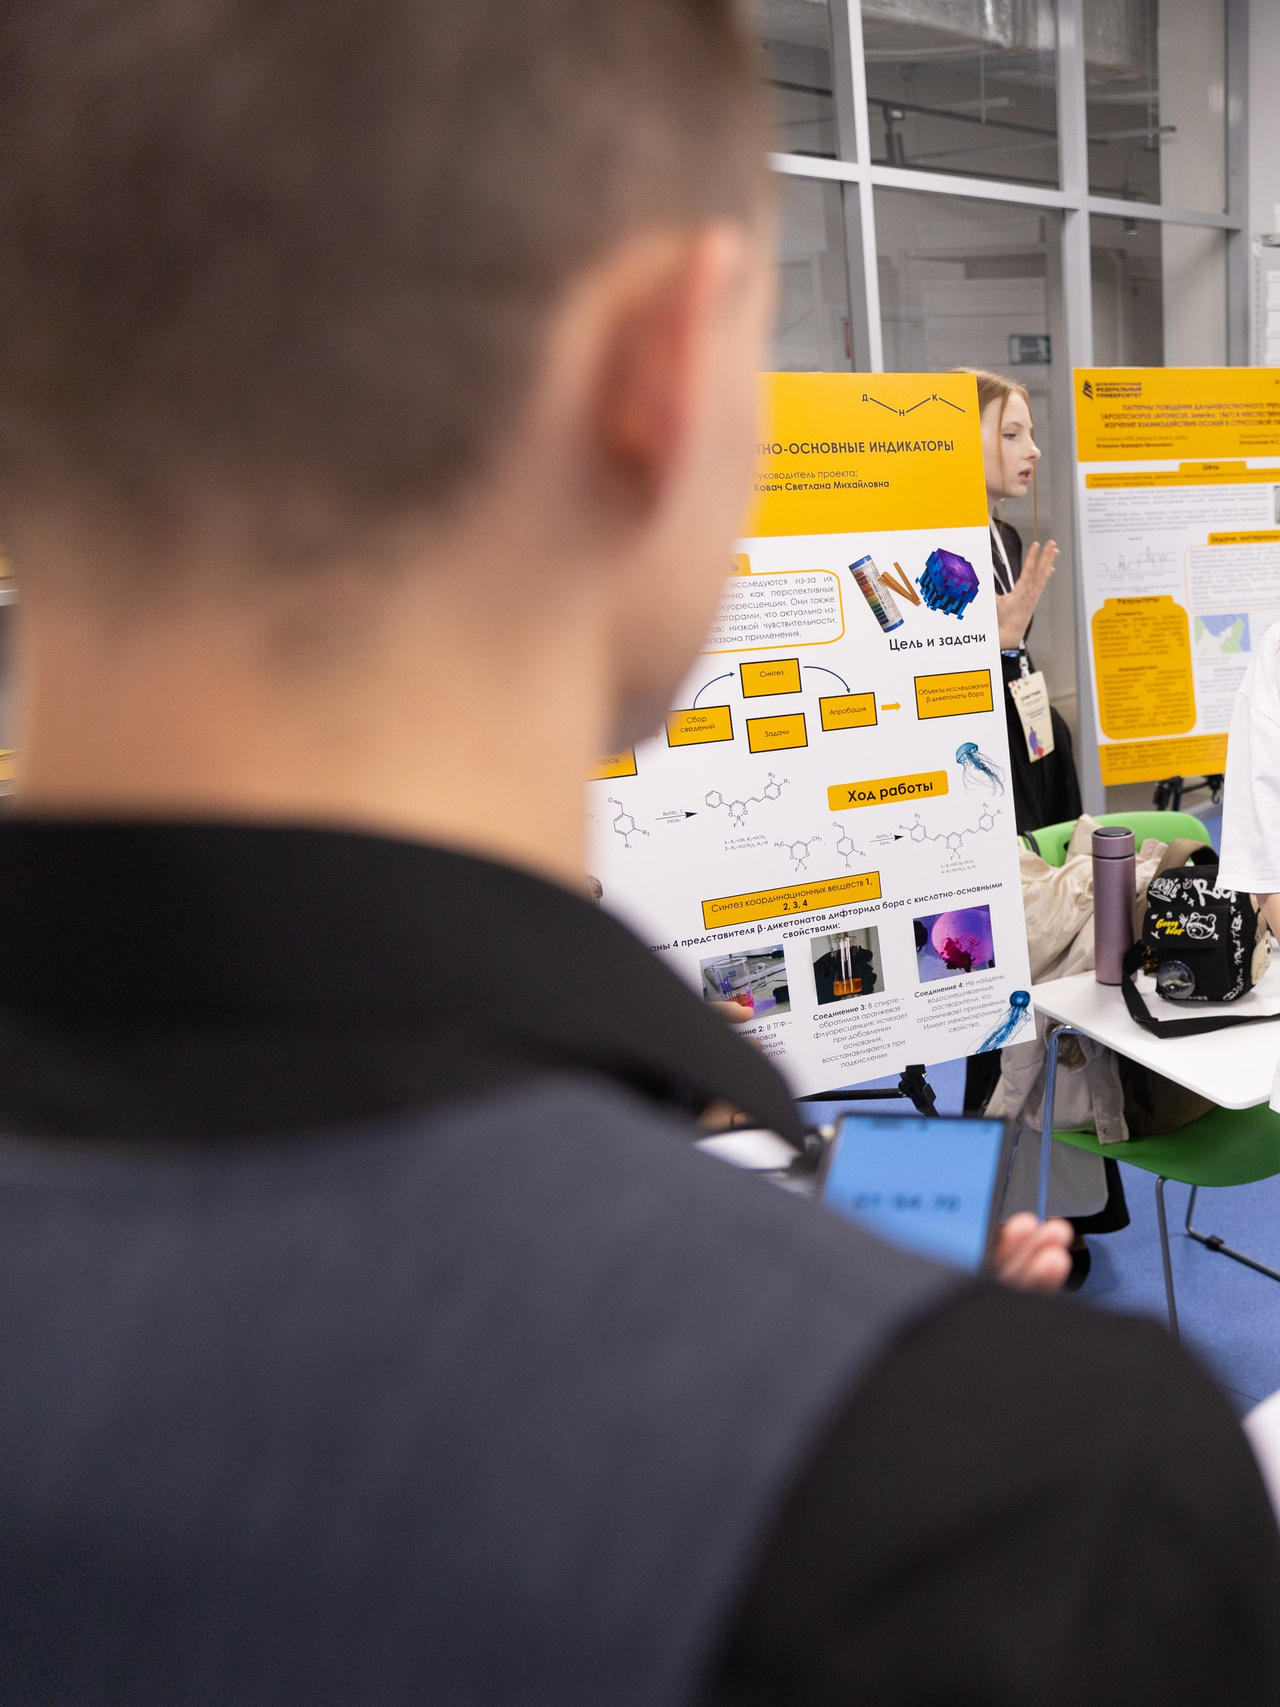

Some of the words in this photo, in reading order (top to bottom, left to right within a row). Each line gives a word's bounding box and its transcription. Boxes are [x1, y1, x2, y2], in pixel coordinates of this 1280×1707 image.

[862, 394, 868, 402] Д
[869, 440, 954, 454] ИНДИКАТОРЫ
[752, 471, 816, 481] Руководитель
[818, 469, 858, 479] проекта:
[754, 483, 783, 492] Ковач
[785, 481, 831, 491] Светлана
[833, 480, 890, 489] Михайловна
[730, 579, 788, 590] исследуются
[795, 577, 816, 585] из-за
[771, 586, 835, 597] перспективных
[790, 598, 808, 606] Они
[810, 596, 835, 605] также
[780, 608, 823, 619] актуально
[729, 622, 759, 632] низкой
[763, 618, 838, 629] чувствительности,
[745, 630, 802, 642] применения.
[889, 638, 923, 651] Цель
[927, 638, 934, 647] и
[939, 633, 986, 646] задачи
[759, 670, 784, 678] Синтез
[918, 687, 944, 696] Объекты
[968, 690, 984, 698] бора
[829, 706, 867, 716] Апробация
[686, 715, 707, 724] Сбор
[680, 723, 716, 733] сведений
[764, 729, 790, 738] Задачи
[847, 789, 876, 803] Ход
[879, 781, 933, 800] работы
[711, 901, 743, 913] Синтез
[745, 887, 827, 908] координационных
[827, 879, 864, 893] веществ
[783, 903, 791, 911] 2,
[793, 901, 800, 909] 3,
[802, 899, 808, 907] 4
[673, 940, 678, 948] 4
[681, 927, 755, 947] представителя
[757, 914, 827, 934] β-дикетонатов
[827, 904, 880, 921] дифторида
[882, 899, 905, 910] бора
[914, 881, 1003, 904] кислотно-основными
[783, 922, 841, 939] свойствами:
[914, 984, 957, 998] Соединение
[976, 974, 1005, 984] найдены
[928, 985, 994, 1004] водосмешиваемые
[813, 1006, 859, 1021] Соединение
[874, 998, 899, 1008] спирте
[917, 1008, 962, 1023] ограничивает
[964, 999, 1008, 1013] применение.
[932, 997, 980, 1012] растворители,
[819, 1015, 860, 1029] обратимая
[861, 1006, 901, 1020] оранжевая
[877, 1013, 908, 1025] исчезает
[924, 1021, 946, 1030] Имеет
[947, 1008, 1003, 1025] механохромные
[773, 1021, 787, 1030] ТГФ
[948, 1022, 980, 1033] свойства.
[832, 1036, 847, 1044] при
[848, 1025, 891, 1041] добавлении
[843, 1037, 883, 1050] основания,
[822, 1042, 890, 1064] восстанавливается
[892, 1039, 906, 1048] при
[840, 1053, 889, 1068] подкислении.
